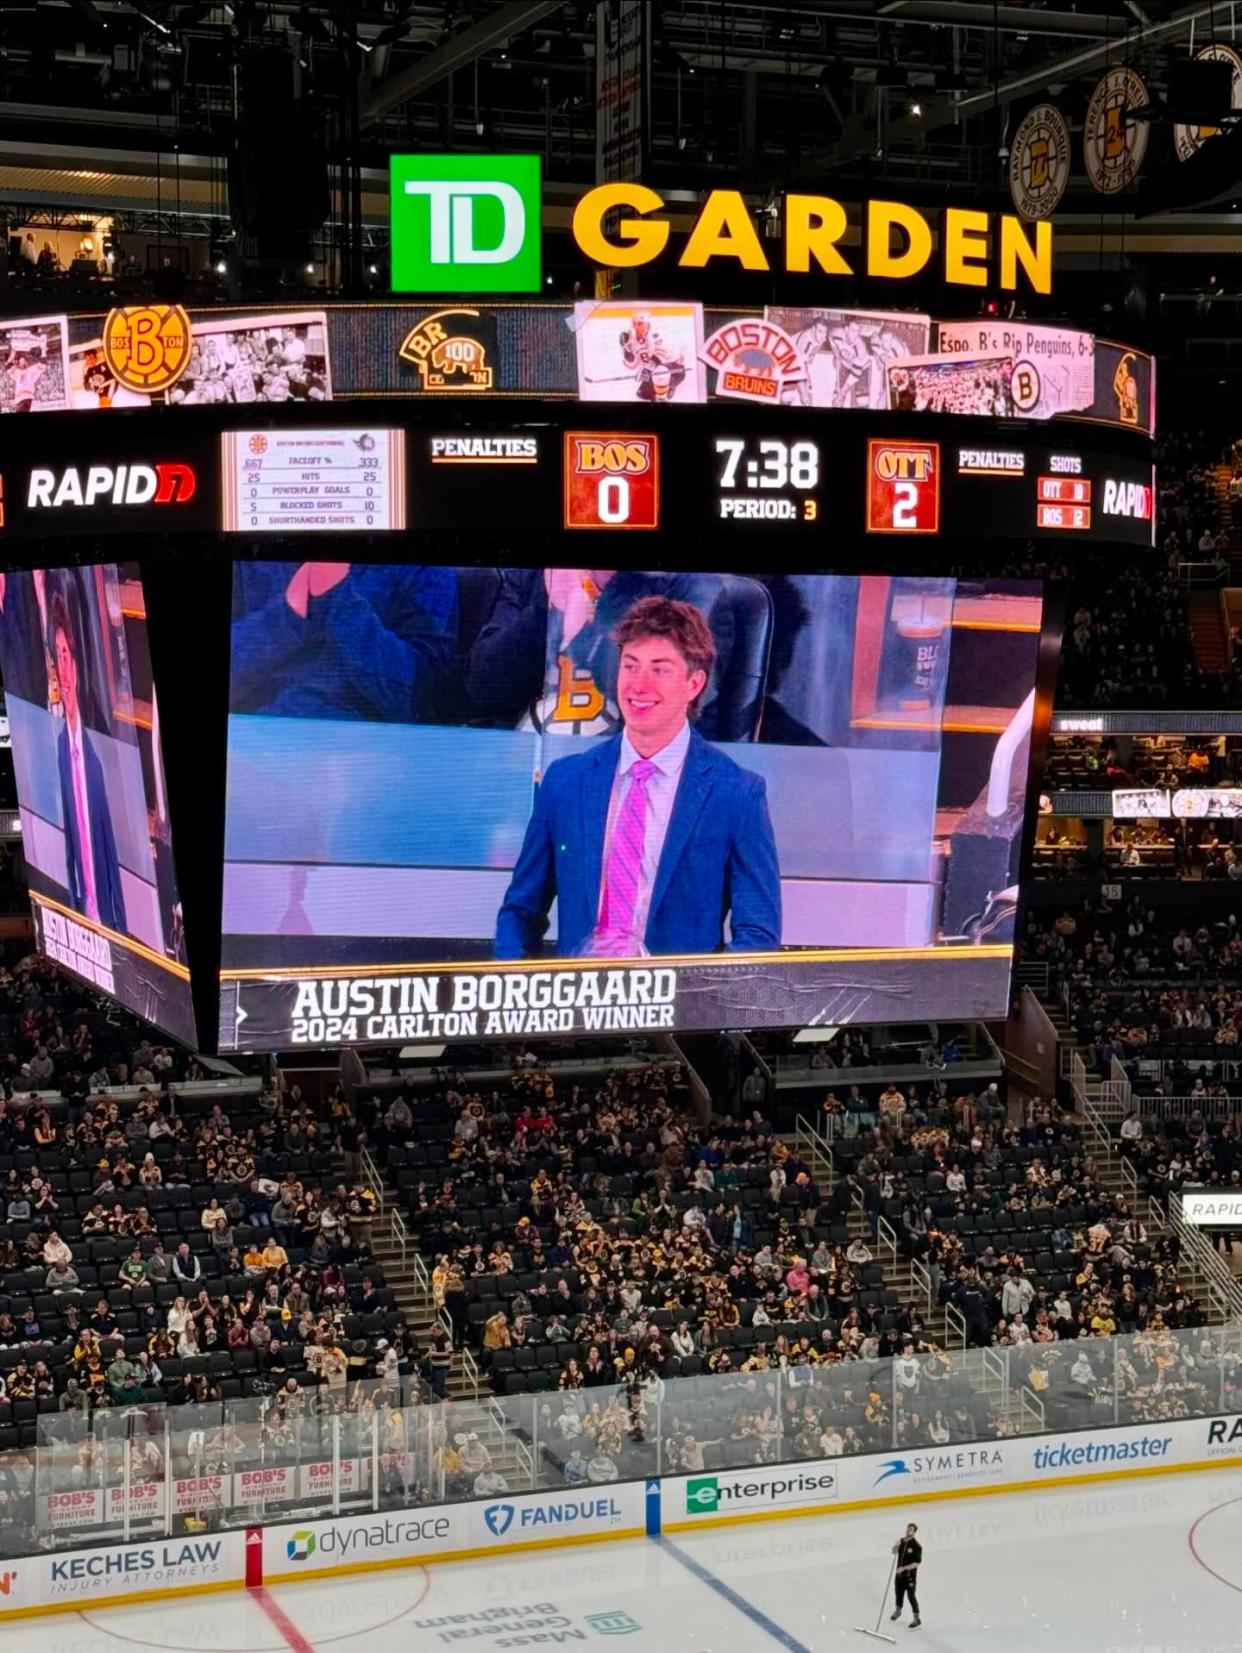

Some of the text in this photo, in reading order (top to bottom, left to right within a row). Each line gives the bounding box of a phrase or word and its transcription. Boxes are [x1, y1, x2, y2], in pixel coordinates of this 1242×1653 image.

[404, 180, 526, 264] TD
[572, 182, 1052, 294] GARDEN
[445, 342, 475, 362] 100
[706, 323, 801, 374] BOSTON
[1003, 332, 1022, 358] Rip
[1026, 331, 1075, 358] Penguins,
[726, 374, 777, 395] BRUINS
[432, 439, 537, 457] PENALTIES
[579, 444, 647, 471] BOS
[959, 450, 1024, 469] PENALTIES
[289, 457, 322, 465] FACEOFF
[715, 440, 819, 490] 7:38
[876, 450, 932, 481] OTT
[1050, 456, 1082, 473] SHOTS
[248, 473, 260, 483] 25
[363, 471, 376, 482] 25
[1043, 481, 1061, 498] OTT
[250, 486, 373, 498] 0 POWERPLAY GOALS 0
[598, 476, 629, 524] 0
[1103, 479, 1151, 520] RAPID
[250, 502, 257, 512] 5
[316, 501, 343, 509] SHOTS
[364, 501, 375, 511] 10
[719, 500, 817, 521] PERIOD: 3
[892, 482, 918, 529] 2
[1043, 508, 1062, 525] BOS
[251, 515, 373, 526] 0 SHORTHANDED SHOTS 0
[291, 969, 677, 1018] AUSTIN BORGGAARD
[291, 1004, 675, 1044] 2024 CARLTON AWARD WINNER
[913, 1449, 1004, 1473] SYMETRA
[1033, 1436, 1173, 1469] ticketmaster
[176, 1477, 222, 1494] BOB'S
[241, 1468, 286, 1486] BOB'S
[309, 1477, 353, 1490] FURNIURE
[692, 1473, 835, 1504] enterprise
[47, 1490, 96, 1508] BOB'S
[47, 1508, 96, 1522] FURNITURE
[521, 1498, 621, 1527] FANDUEL
[319, 1517, 450, 1556] dynatrace
[51, 1541, 222, 1582] KECHES LAW
[51, 1562, 220, 1594] INJURY ATTORNEYS
[414, 1602, 559, 1629] Brigham
[437, 1616, 572, 1644] General
[495, 1628, 588, 1648] Mass
